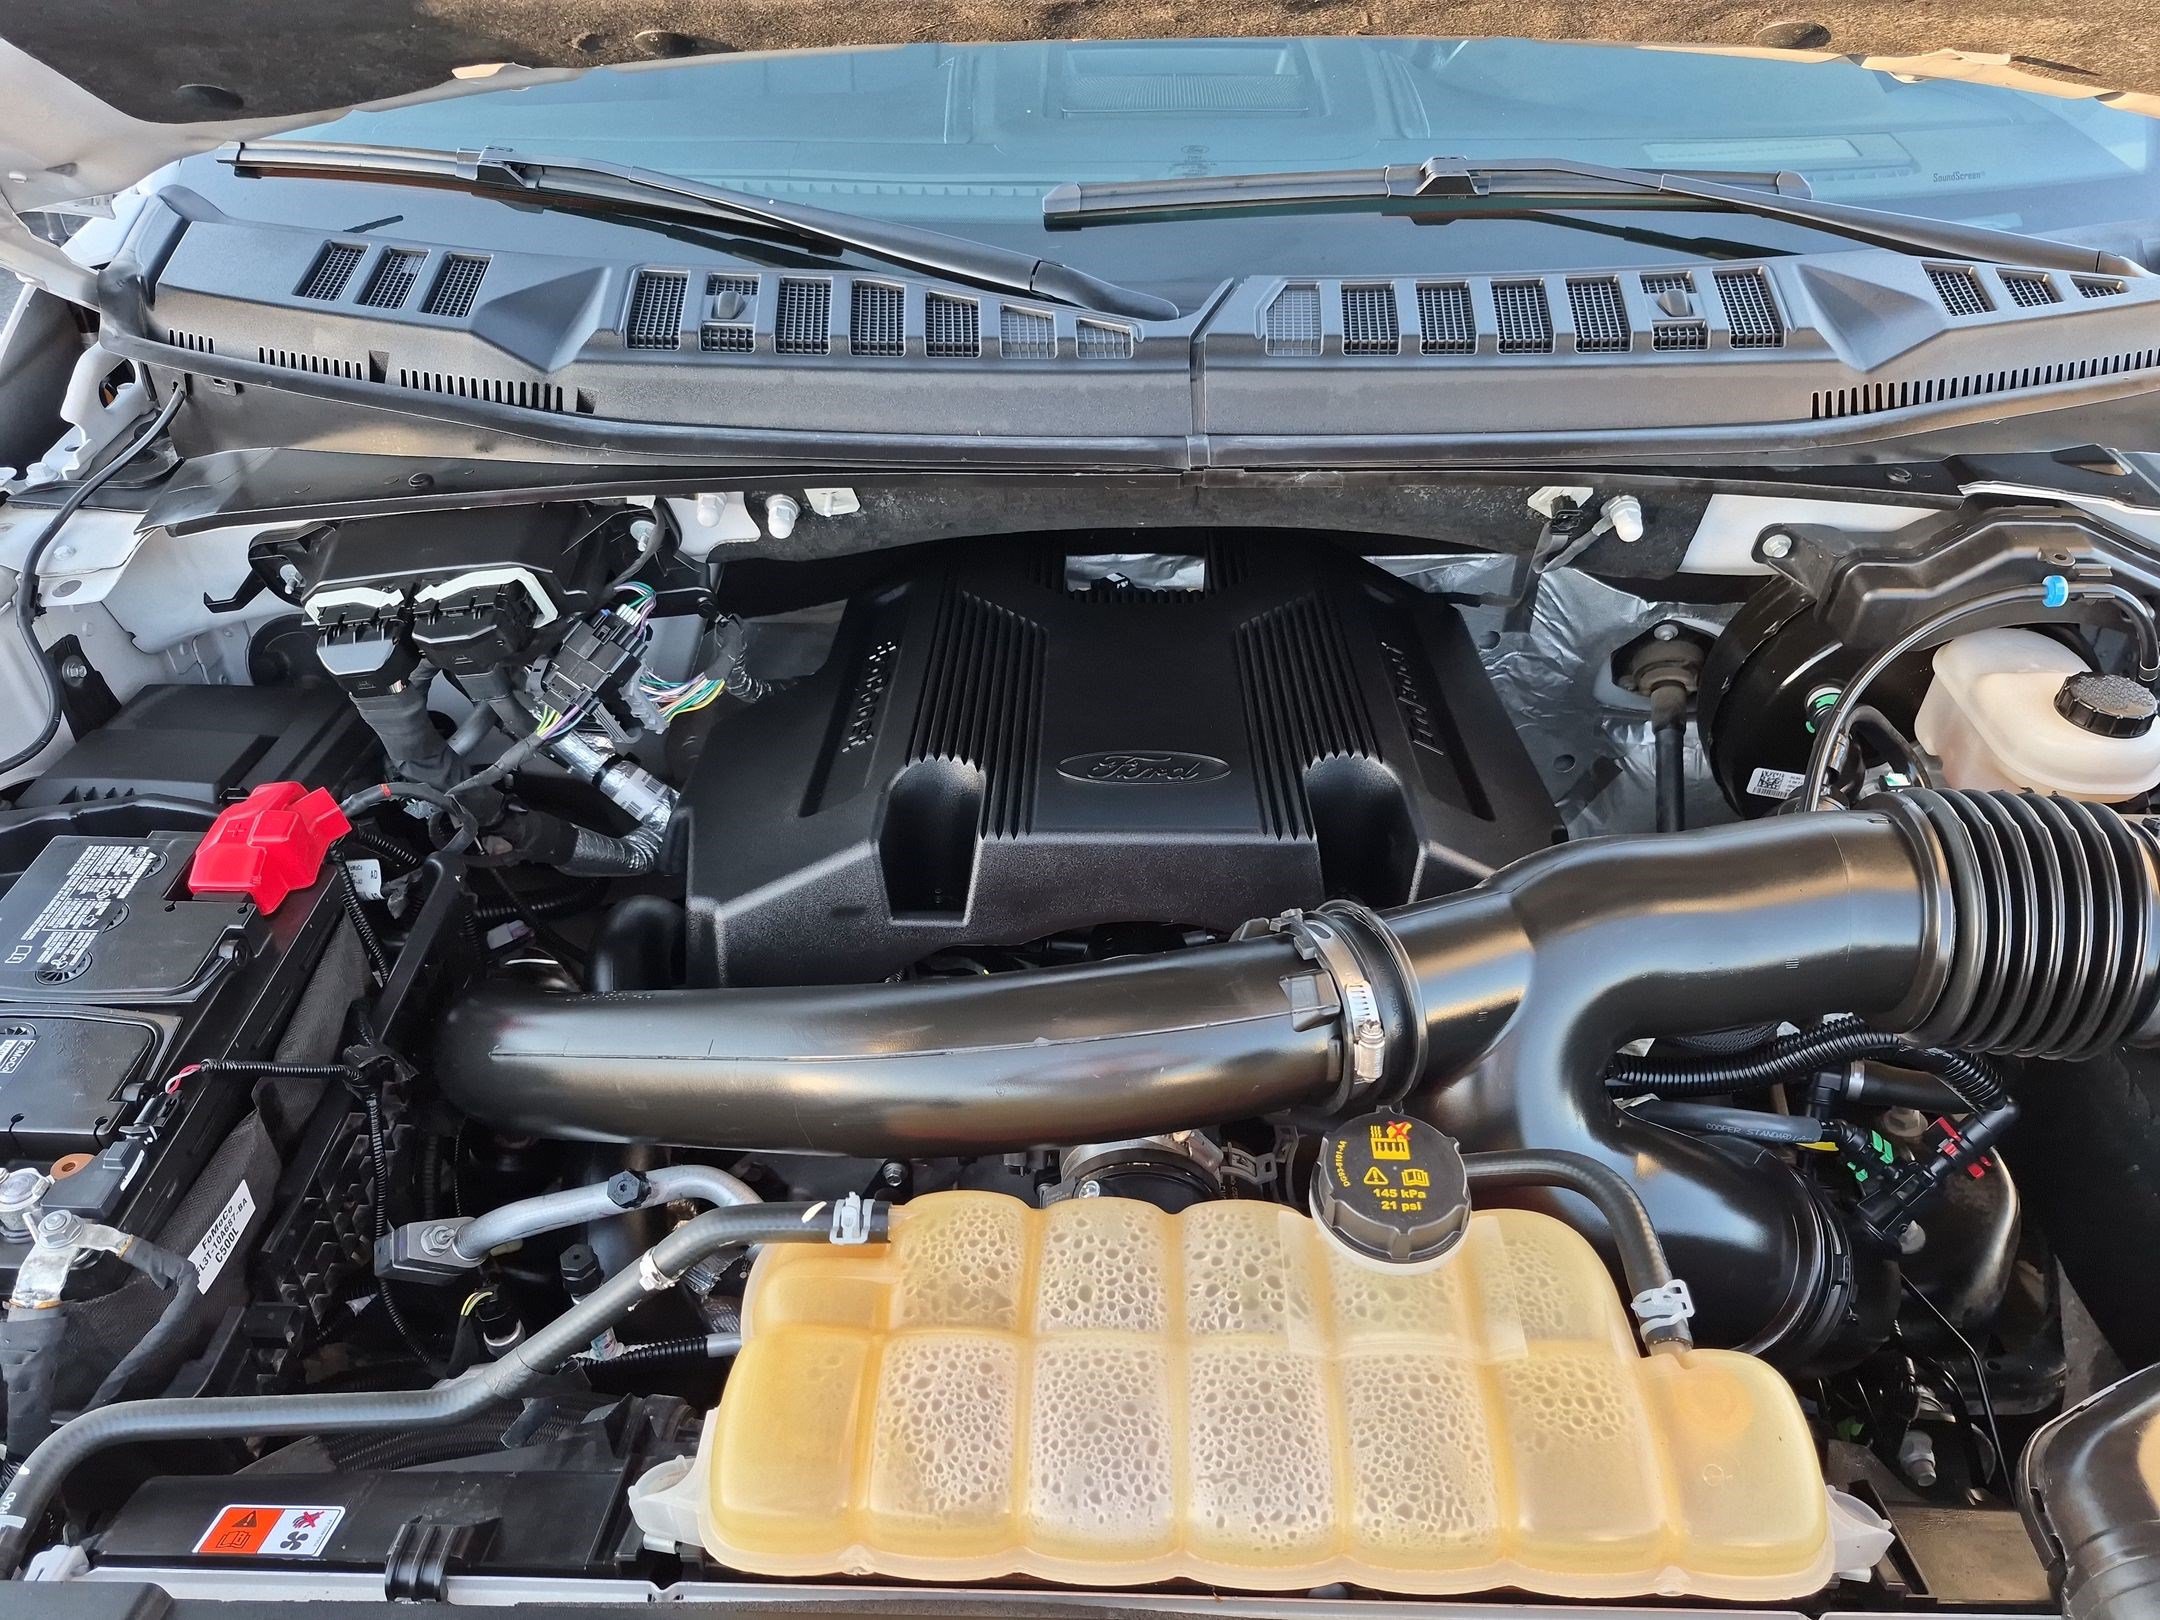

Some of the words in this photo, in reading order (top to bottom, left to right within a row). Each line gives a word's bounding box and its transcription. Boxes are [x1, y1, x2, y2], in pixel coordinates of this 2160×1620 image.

[1932, 171, 1981, 182] SoundScreen
[1083, 754, 1204, 782] Ford
[1706, 1122, 1742, 1134] COOPER
[1746, 1128, 1792, 1141] STANDARD
[1373, 1188, 1398, 1199] 145
[1401, 1188, 1427, 1199] kPa
[1381, 1201, 1398, 1211] 21
[1401, 1202, 1422, 1212] psi
[201, 1205, 233, 1250] FoMoCo
[214, 1227, 239, 1264] C500L
